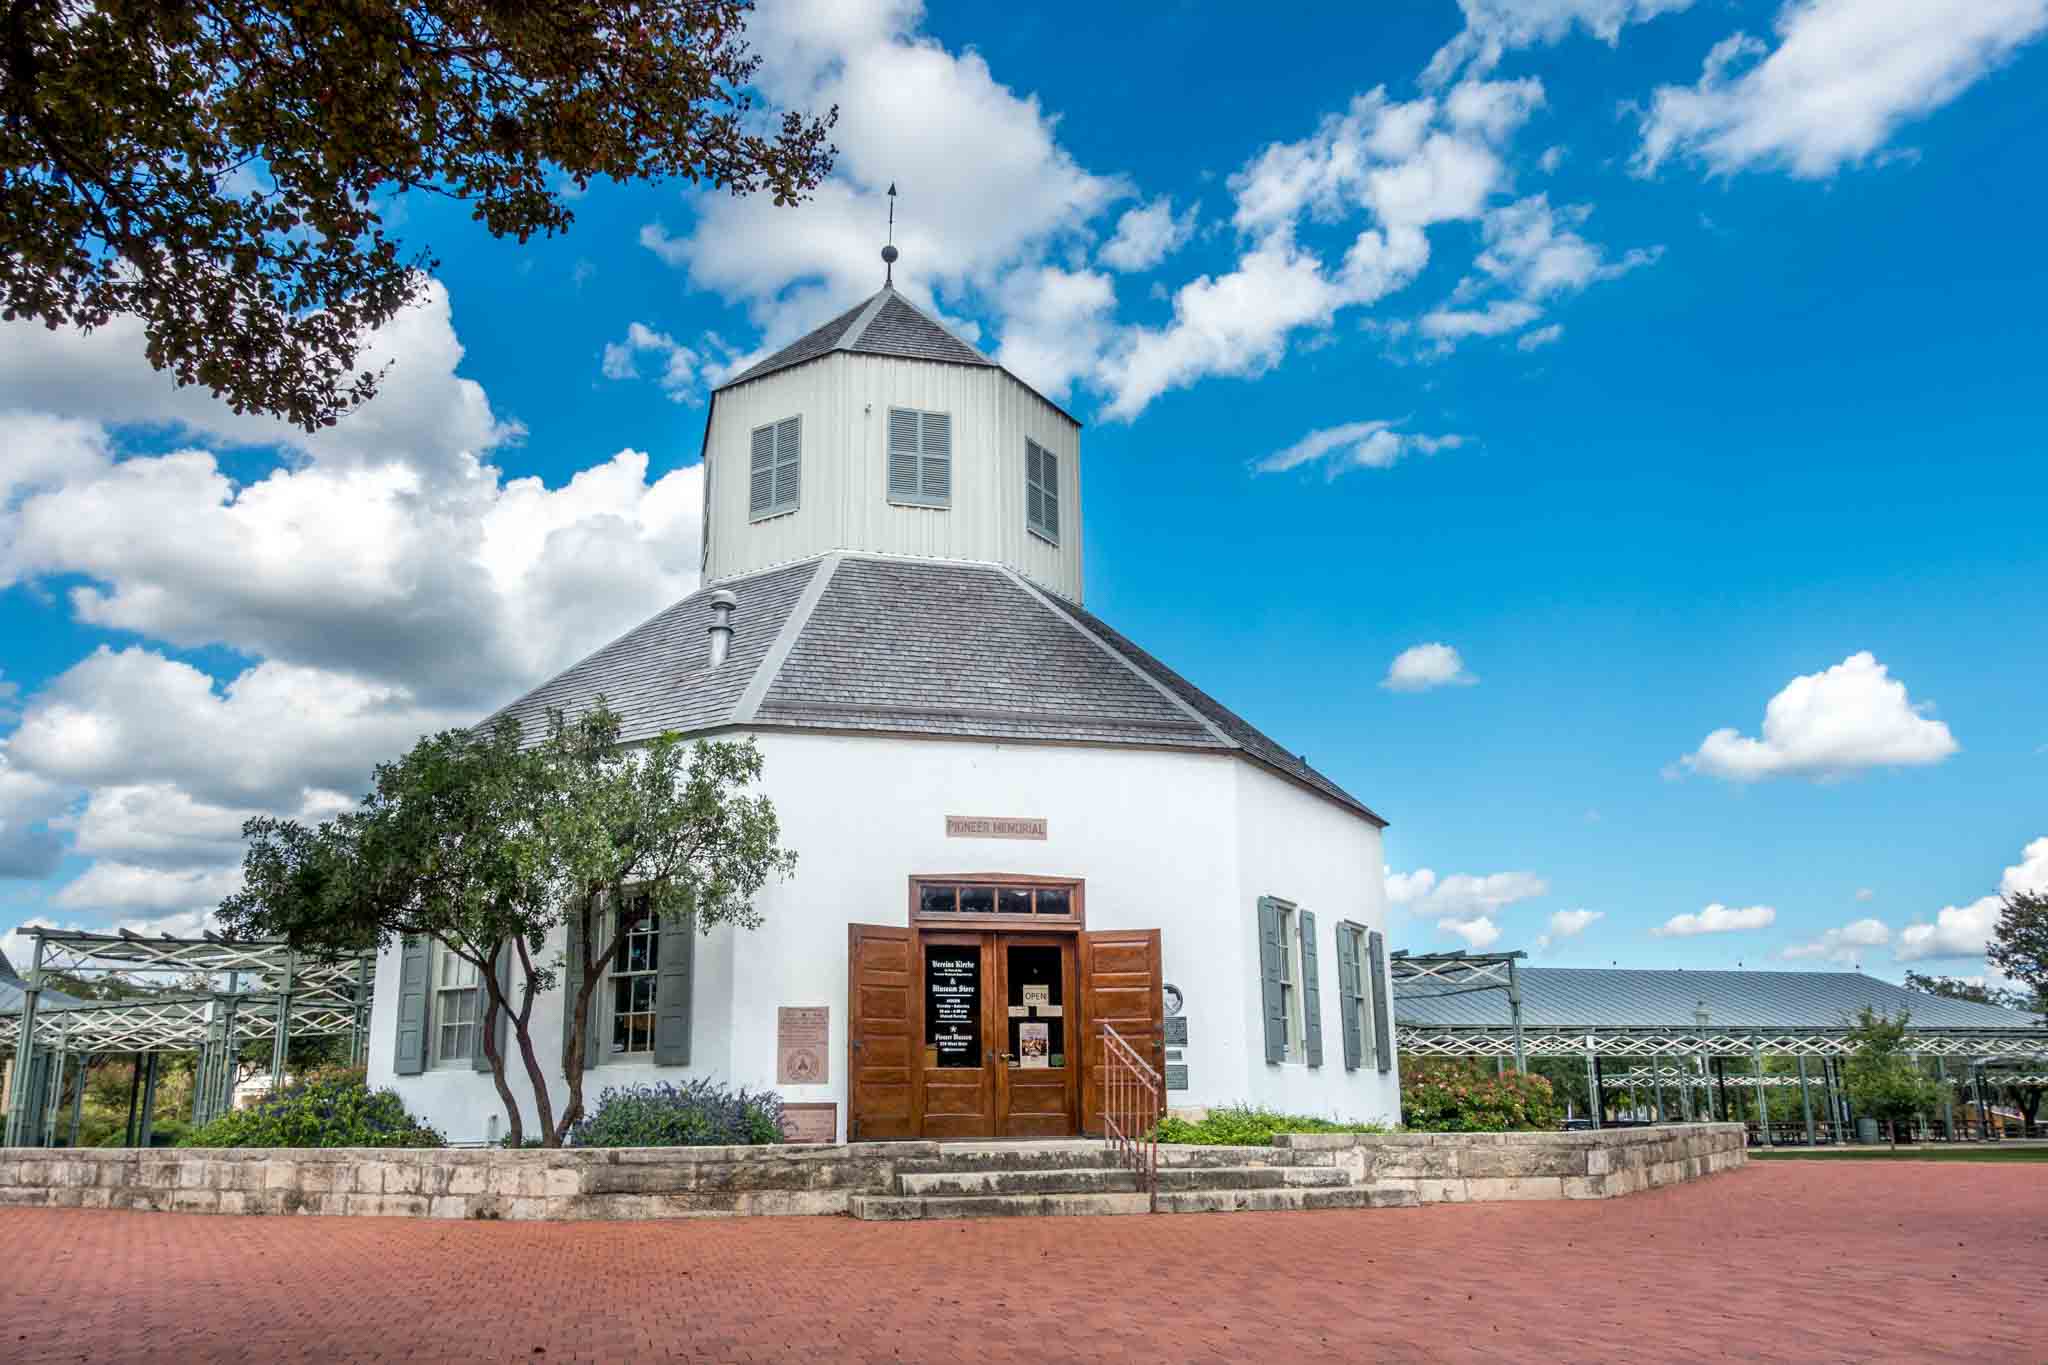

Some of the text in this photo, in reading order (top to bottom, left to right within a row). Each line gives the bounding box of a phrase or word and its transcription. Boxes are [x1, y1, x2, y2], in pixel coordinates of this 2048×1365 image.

[946, 819, 1046, 834] PIONEER MEMORIAL
[932, 984, 975, 992] Museum Store
[1024, 992, 1048, 1000] OPEN
